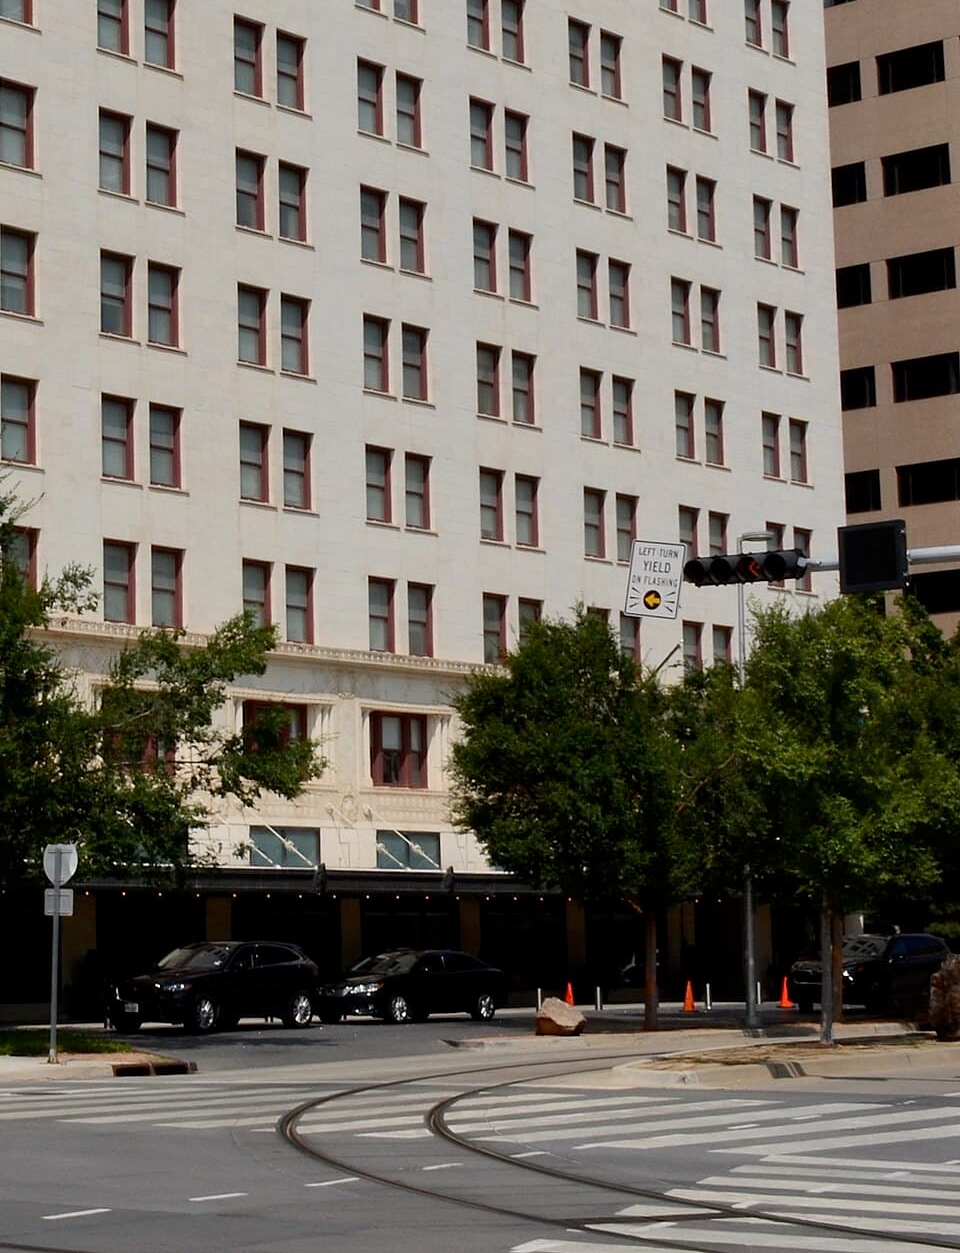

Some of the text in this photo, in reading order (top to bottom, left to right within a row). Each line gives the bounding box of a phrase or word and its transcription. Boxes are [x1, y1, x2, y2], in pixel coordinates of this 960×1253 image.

[639, 547, 679, 558] LEFT TURN
[643, 560, 671, 573] YIELD
[632, 575, 678, 588] ON FLASHING
